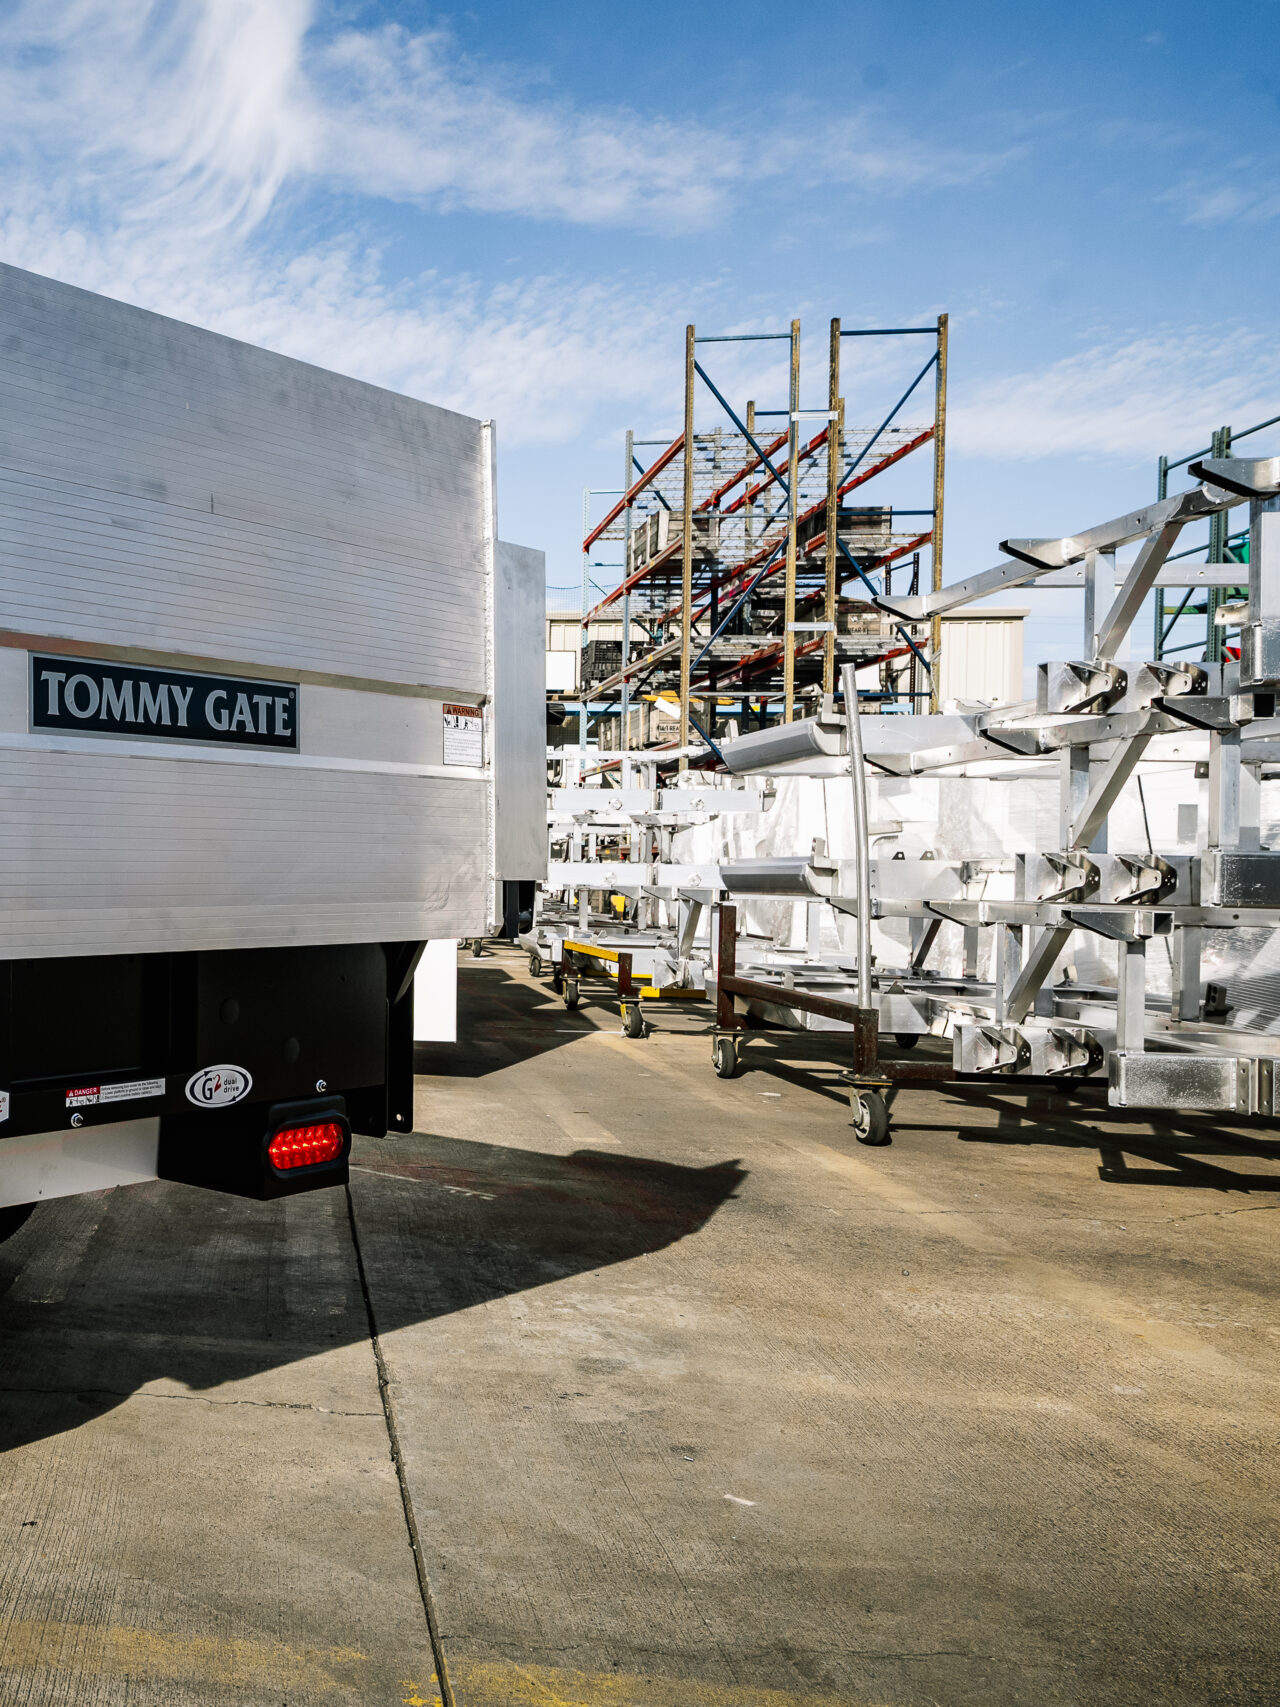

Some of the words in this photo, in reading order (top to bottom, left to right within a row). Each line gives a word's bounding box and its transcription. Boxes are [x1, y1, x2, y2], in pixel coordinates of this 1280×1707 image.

[40, 670, 194, 727] TOMMY
[204, 689, 292, 737] GATE
[452, 706, 479, 717] WARNING
[223, 1077, 237, 1086] dual
[74, 1087, 98, 1096] DANGER
